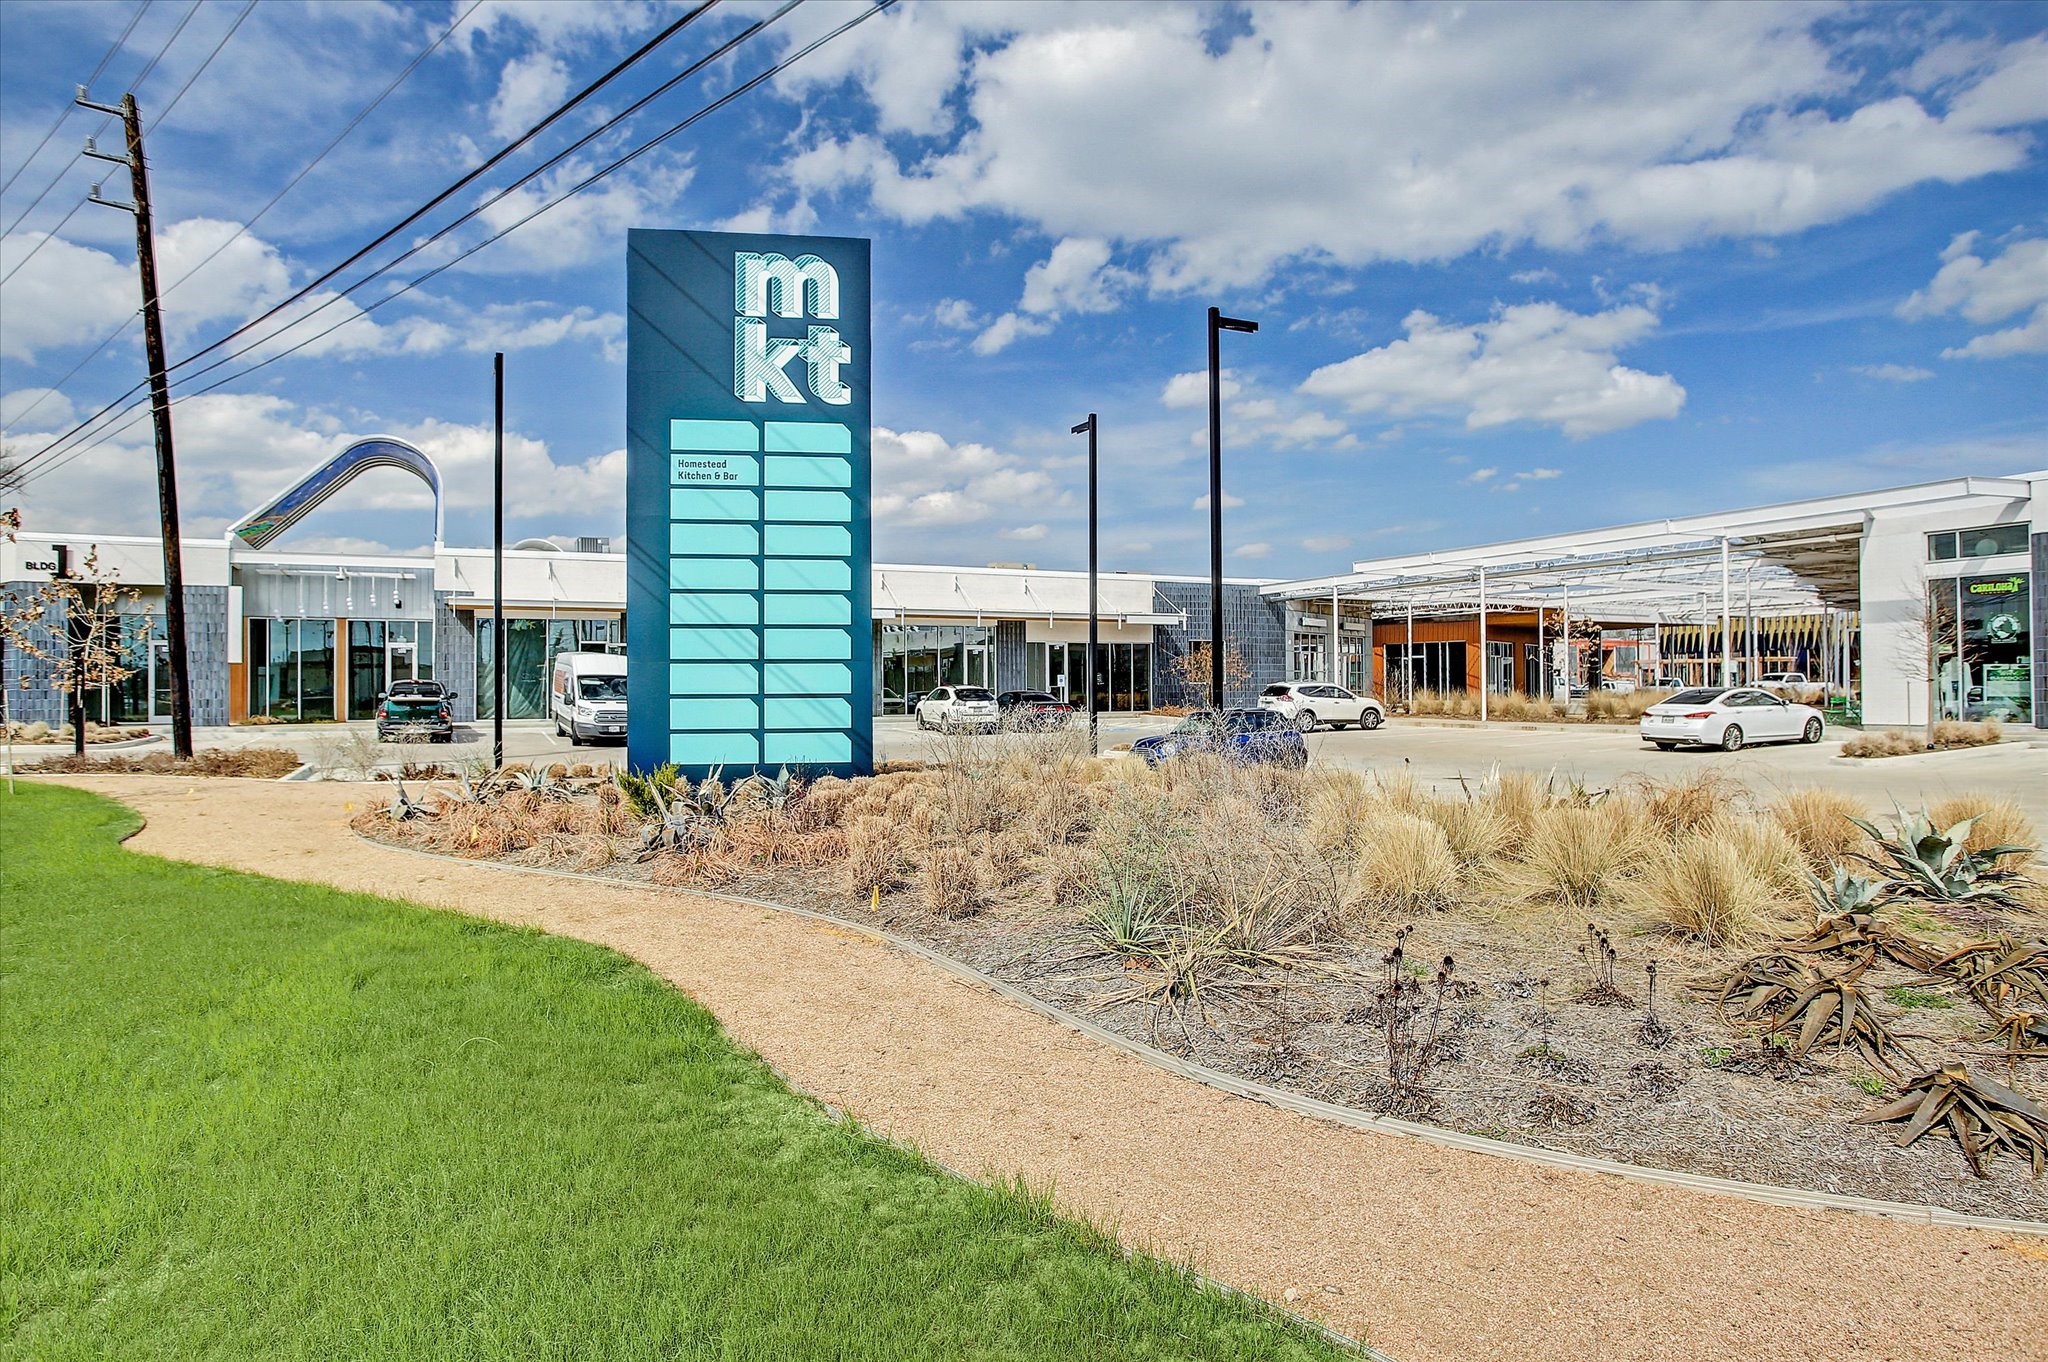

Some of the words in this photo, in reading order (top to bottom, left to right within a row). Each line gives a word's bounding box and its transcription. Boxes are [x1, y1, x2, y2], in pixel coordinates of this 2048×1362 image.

[678, 459, 727, 468] Homestead
[678, 471, 712, 480] Kitchen
[714, 472, 721, 480] &
[723, 472, 738, 481] Bar
[25, 561, 56, 570] BLDG
[50, 544, 72, 579] 1
